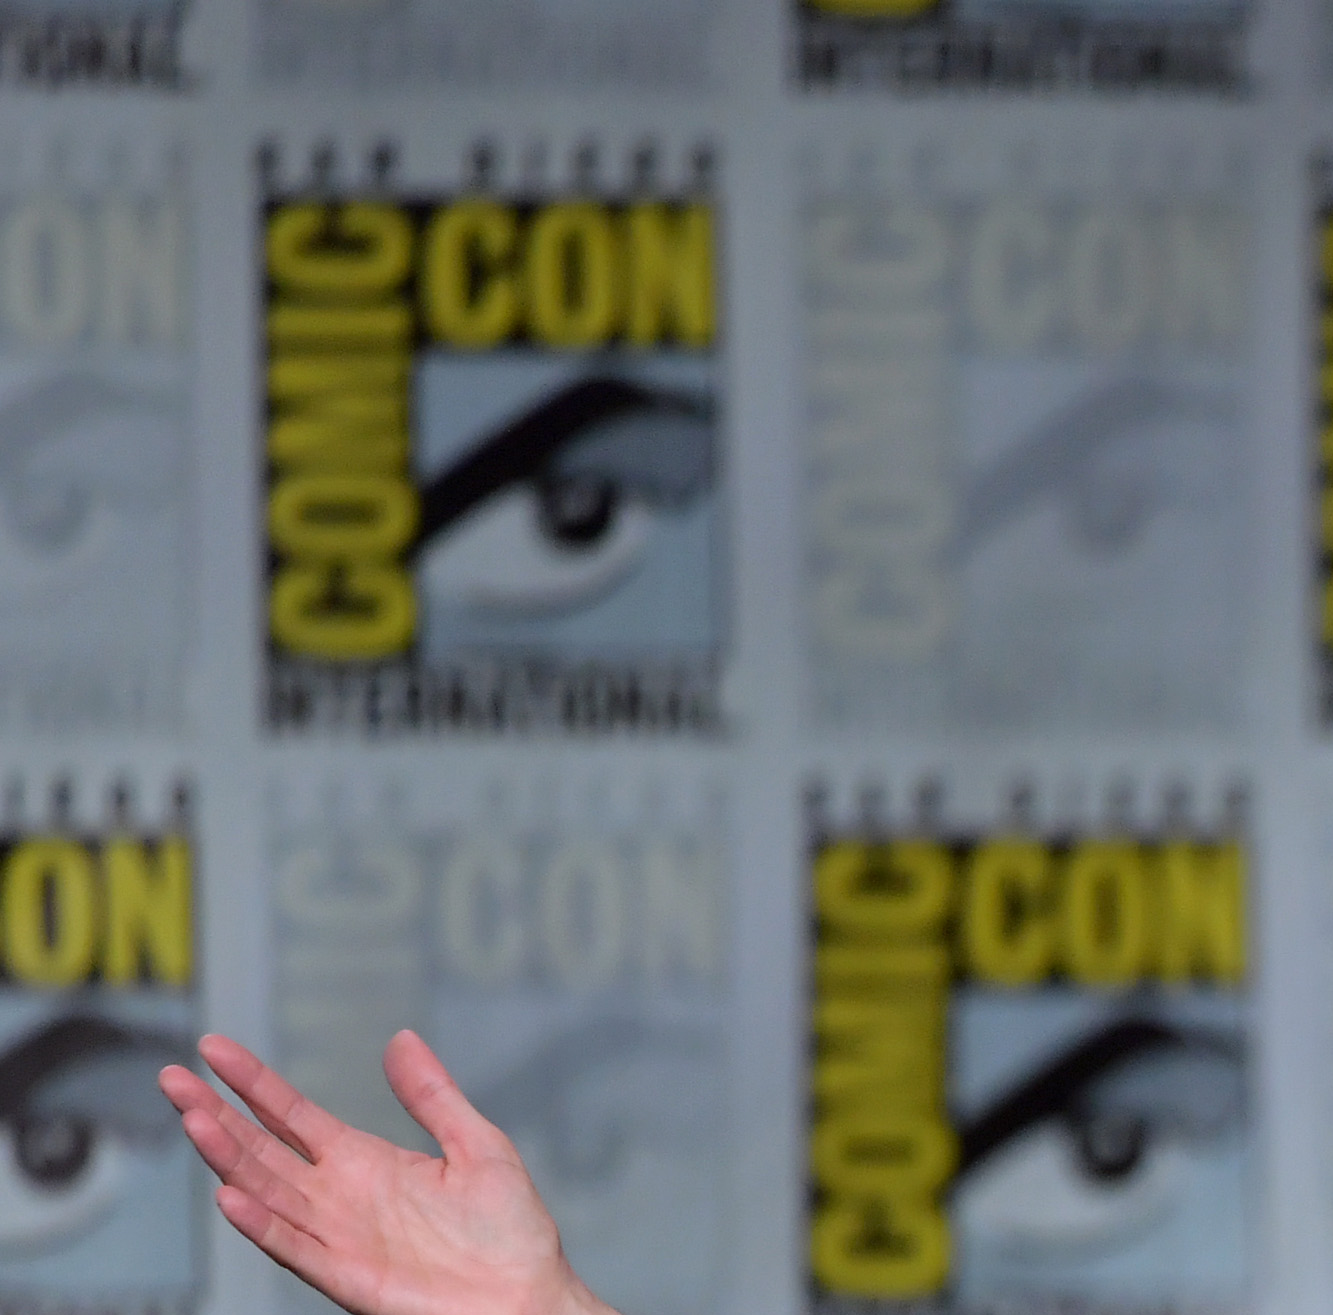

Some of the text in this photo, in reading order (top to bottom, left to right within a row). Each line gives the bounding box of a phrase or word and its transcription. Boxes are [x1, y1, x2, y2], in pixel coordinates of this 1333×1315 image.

[0, 200, 190, 346] ON
[422, 200, 716, 350] CON
[262, 205, 418, 662] COMIC
[0, 836, 192, 988] ON
[965, 838, 1246, 986] CON
[808, 840, 958, 1298] COMIC
